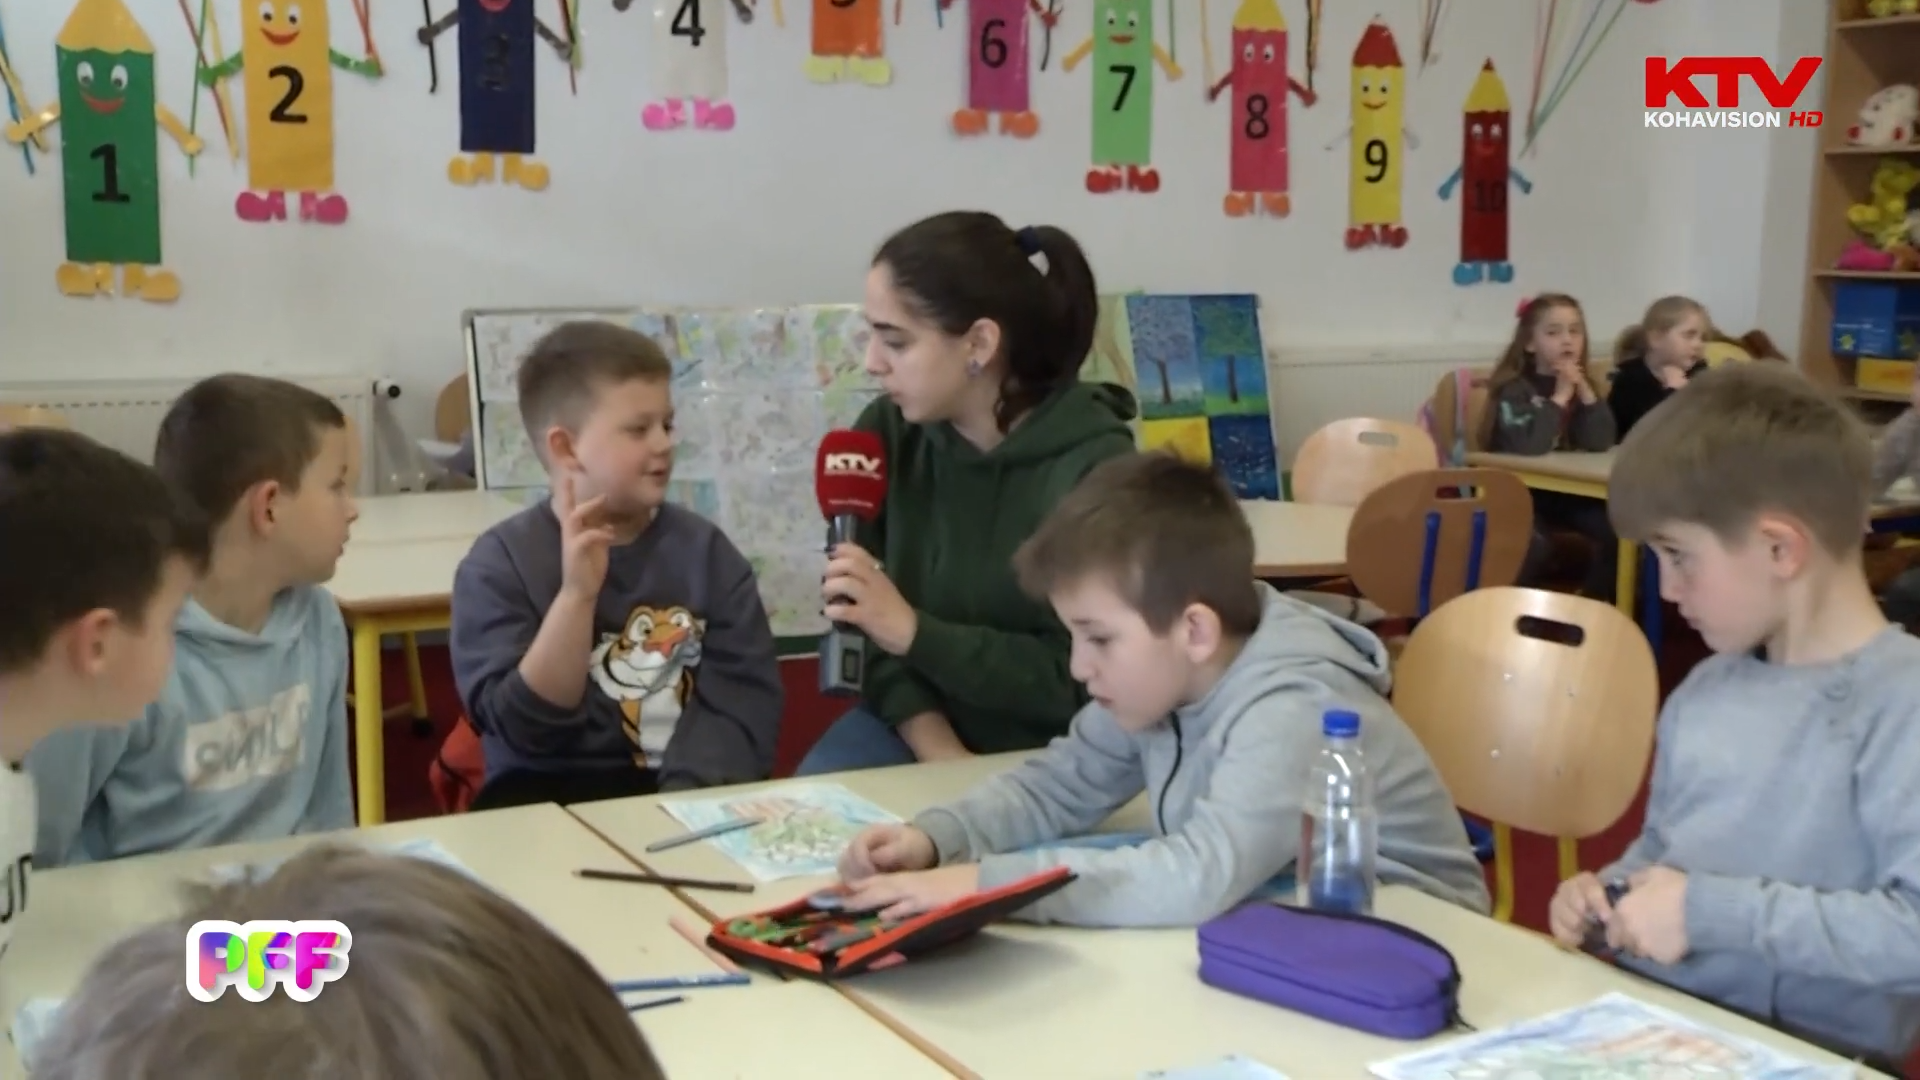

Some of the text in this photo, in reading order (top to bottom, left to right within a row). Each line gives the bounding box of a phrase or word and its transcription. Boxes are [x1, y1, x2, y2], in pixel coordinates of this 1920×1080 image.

[671, 0, 706, 47] 4
[980, 19, 1007, 68] 6
[268, 65, 308, 124] 2
[1109, 65, 1137, 111] 7
[1245, 93, 1269, 140] 8
[89, 143, 130, 203] 1
[1365, 139, 1388, 183] 9
[1474, 180, 1507, 213] 10
[825, 452, 881, 472] KTV
